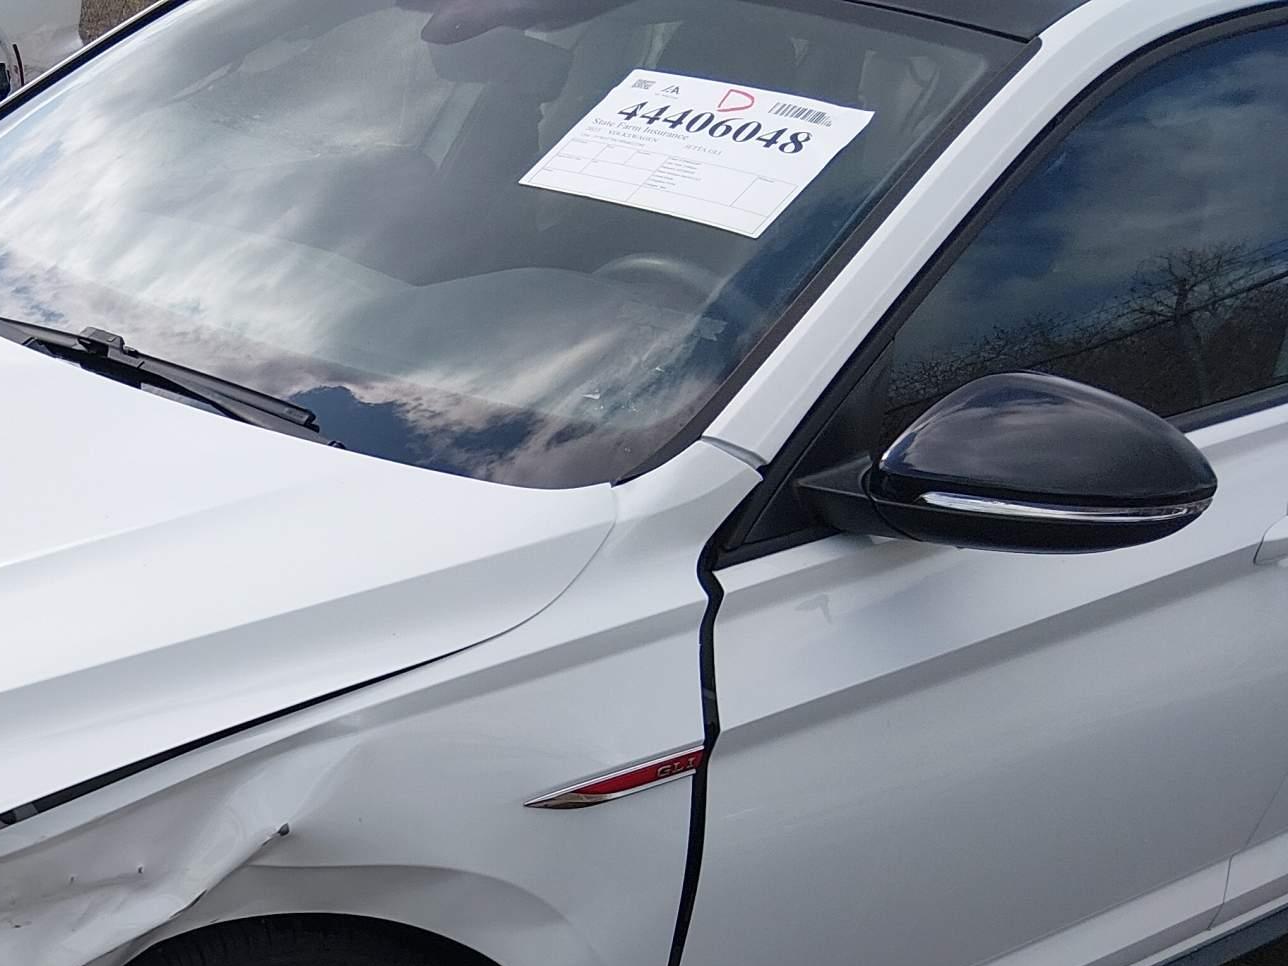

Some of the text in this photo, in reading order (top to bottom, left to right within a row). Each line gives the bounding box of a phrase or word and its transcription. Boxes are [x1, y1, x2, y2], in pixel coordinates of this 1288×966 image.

[717, 88, 755, 112] D
[592, 117, 613, 128] State
[616, 121, 641, 133] Farm
[643, 126, 689, 141] Insurance
[617, 100, 811, 154] 44406048
[657, 757, 696, 777] GLI
